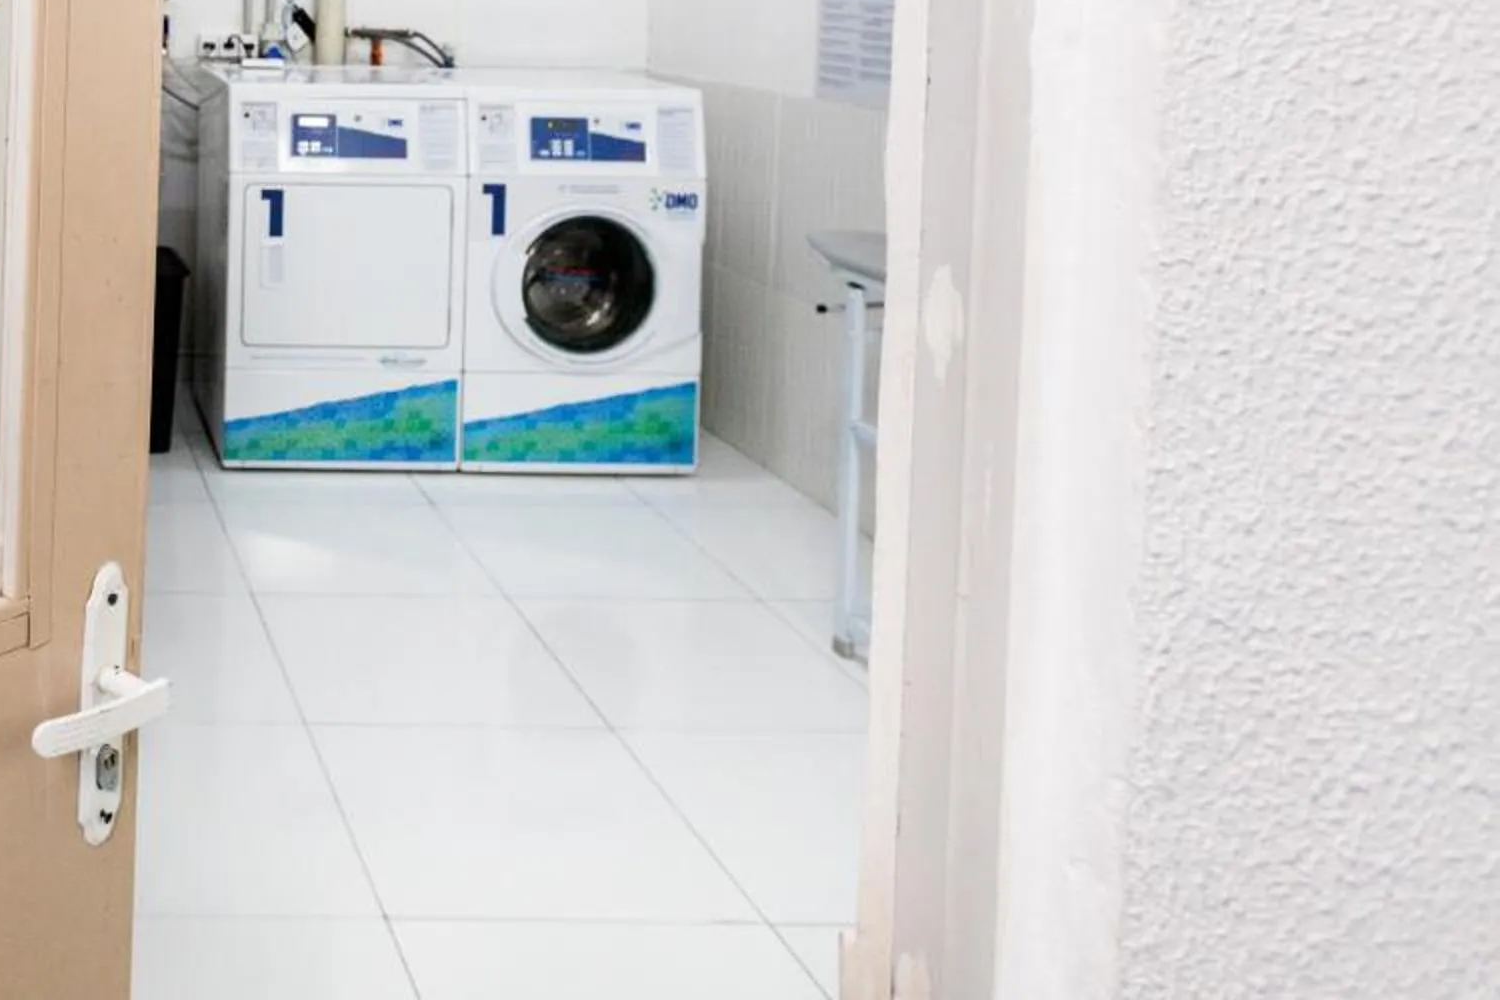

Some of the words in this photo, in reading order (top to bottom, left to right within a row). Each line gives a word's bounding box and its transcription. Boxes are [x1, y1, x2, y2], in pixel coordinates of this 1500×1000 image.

[261, 189, 284, 237] 1
[482, 183, 506, 235] 1
[665, 193, 698, 210] OMO
